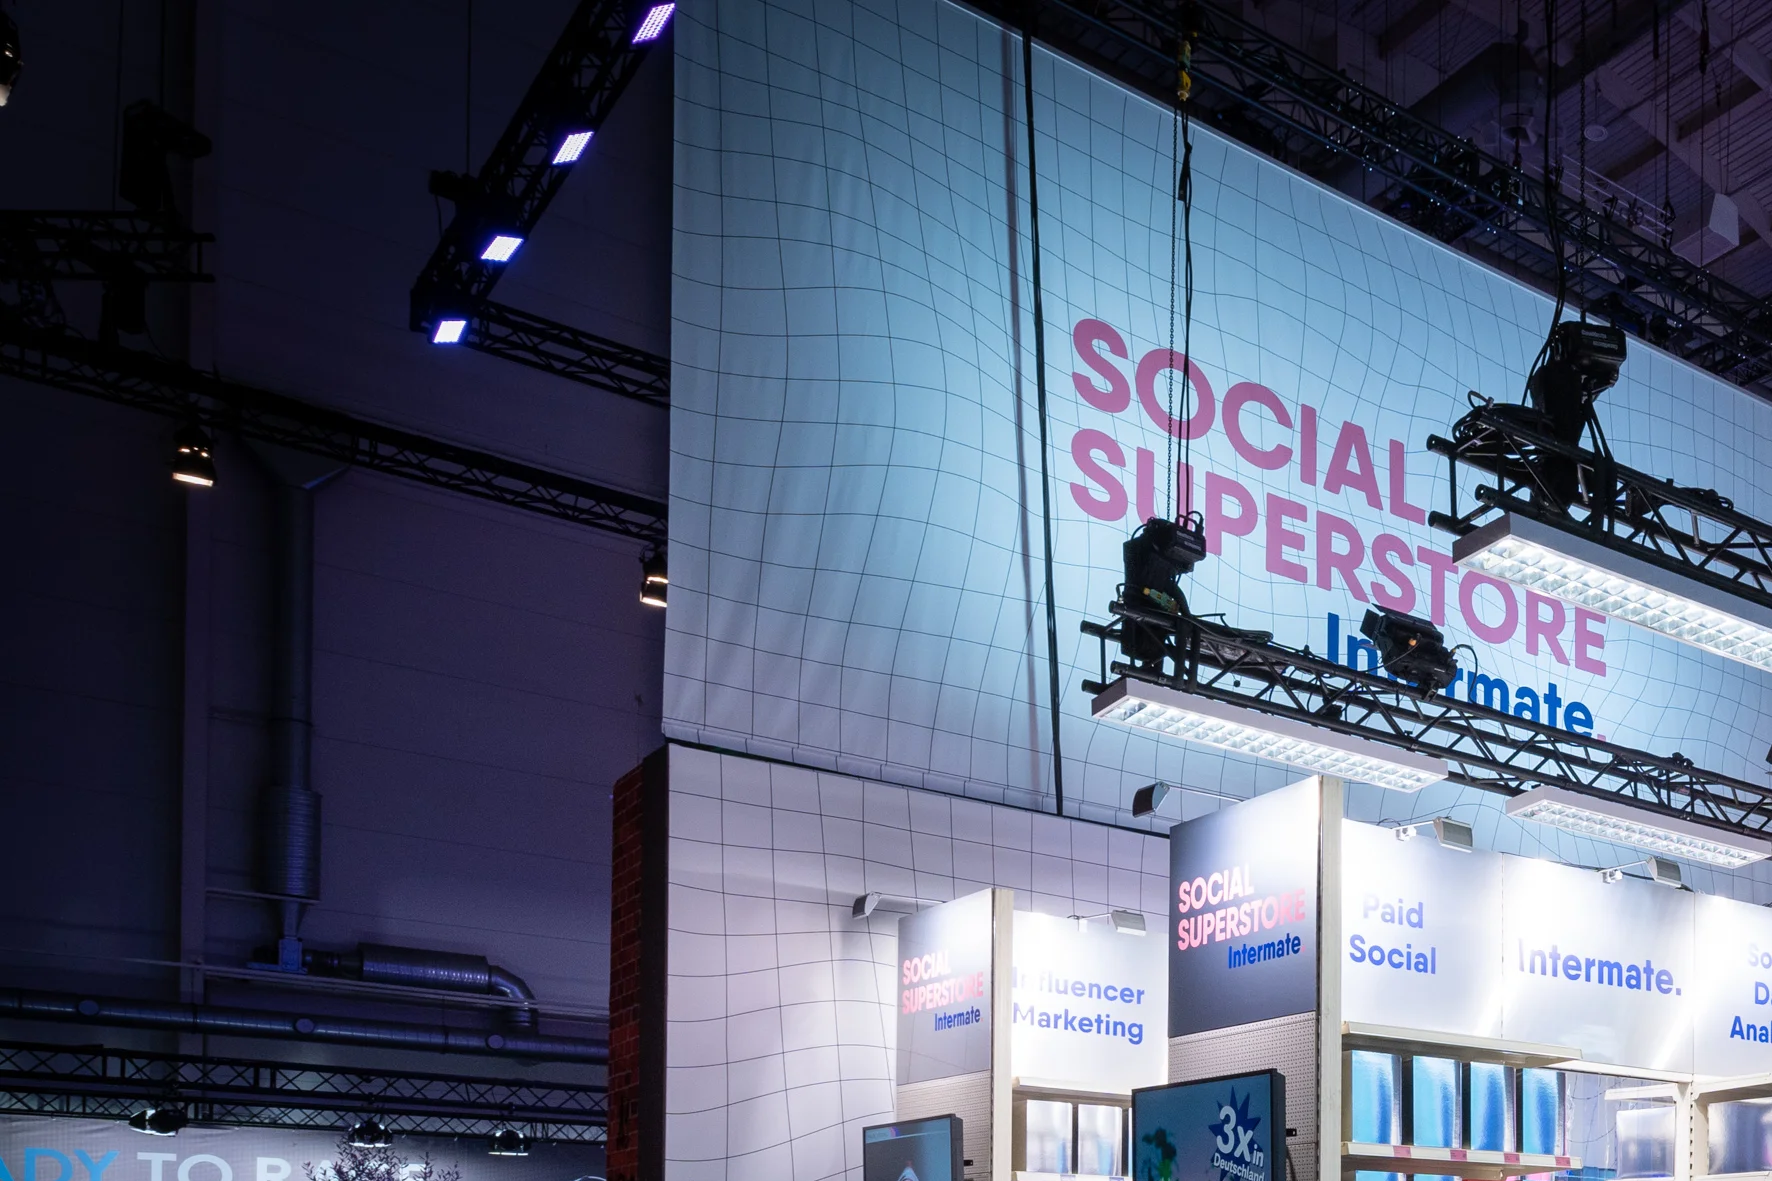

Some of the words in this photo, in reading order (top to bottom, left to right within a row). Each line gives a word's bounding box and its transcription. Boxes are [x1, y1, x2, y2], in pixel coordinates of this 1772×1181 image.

[1072, 318, 1426, 526] SOCIAL
[1069, 429, 1607, 677] SUPERSTORE
[1327, 612, 1606, 745] Inrmate.
[1178, 863, 1255, 913] SOCIAL
[1361, 893, 1424, 929] Paid
[1177, 888, 1306, 951] SUPERSTORE
[902, 950, 952, 985] SOCIAL
[1228, 932, 1306, 969] Intermate.
[1349, 934, 1437, 975] Social
[1518, 938, 1682, 996] Intermate.
[902, 971, 984, 1014] SUPERSTORE
[934, 1005, 984, 1032] Intermate.
[1012, 1002, 1144, 1046] Marketing
[1216, 1105, 1251, 1163] 3x
[1252, 1143, 1265, 1168] in
